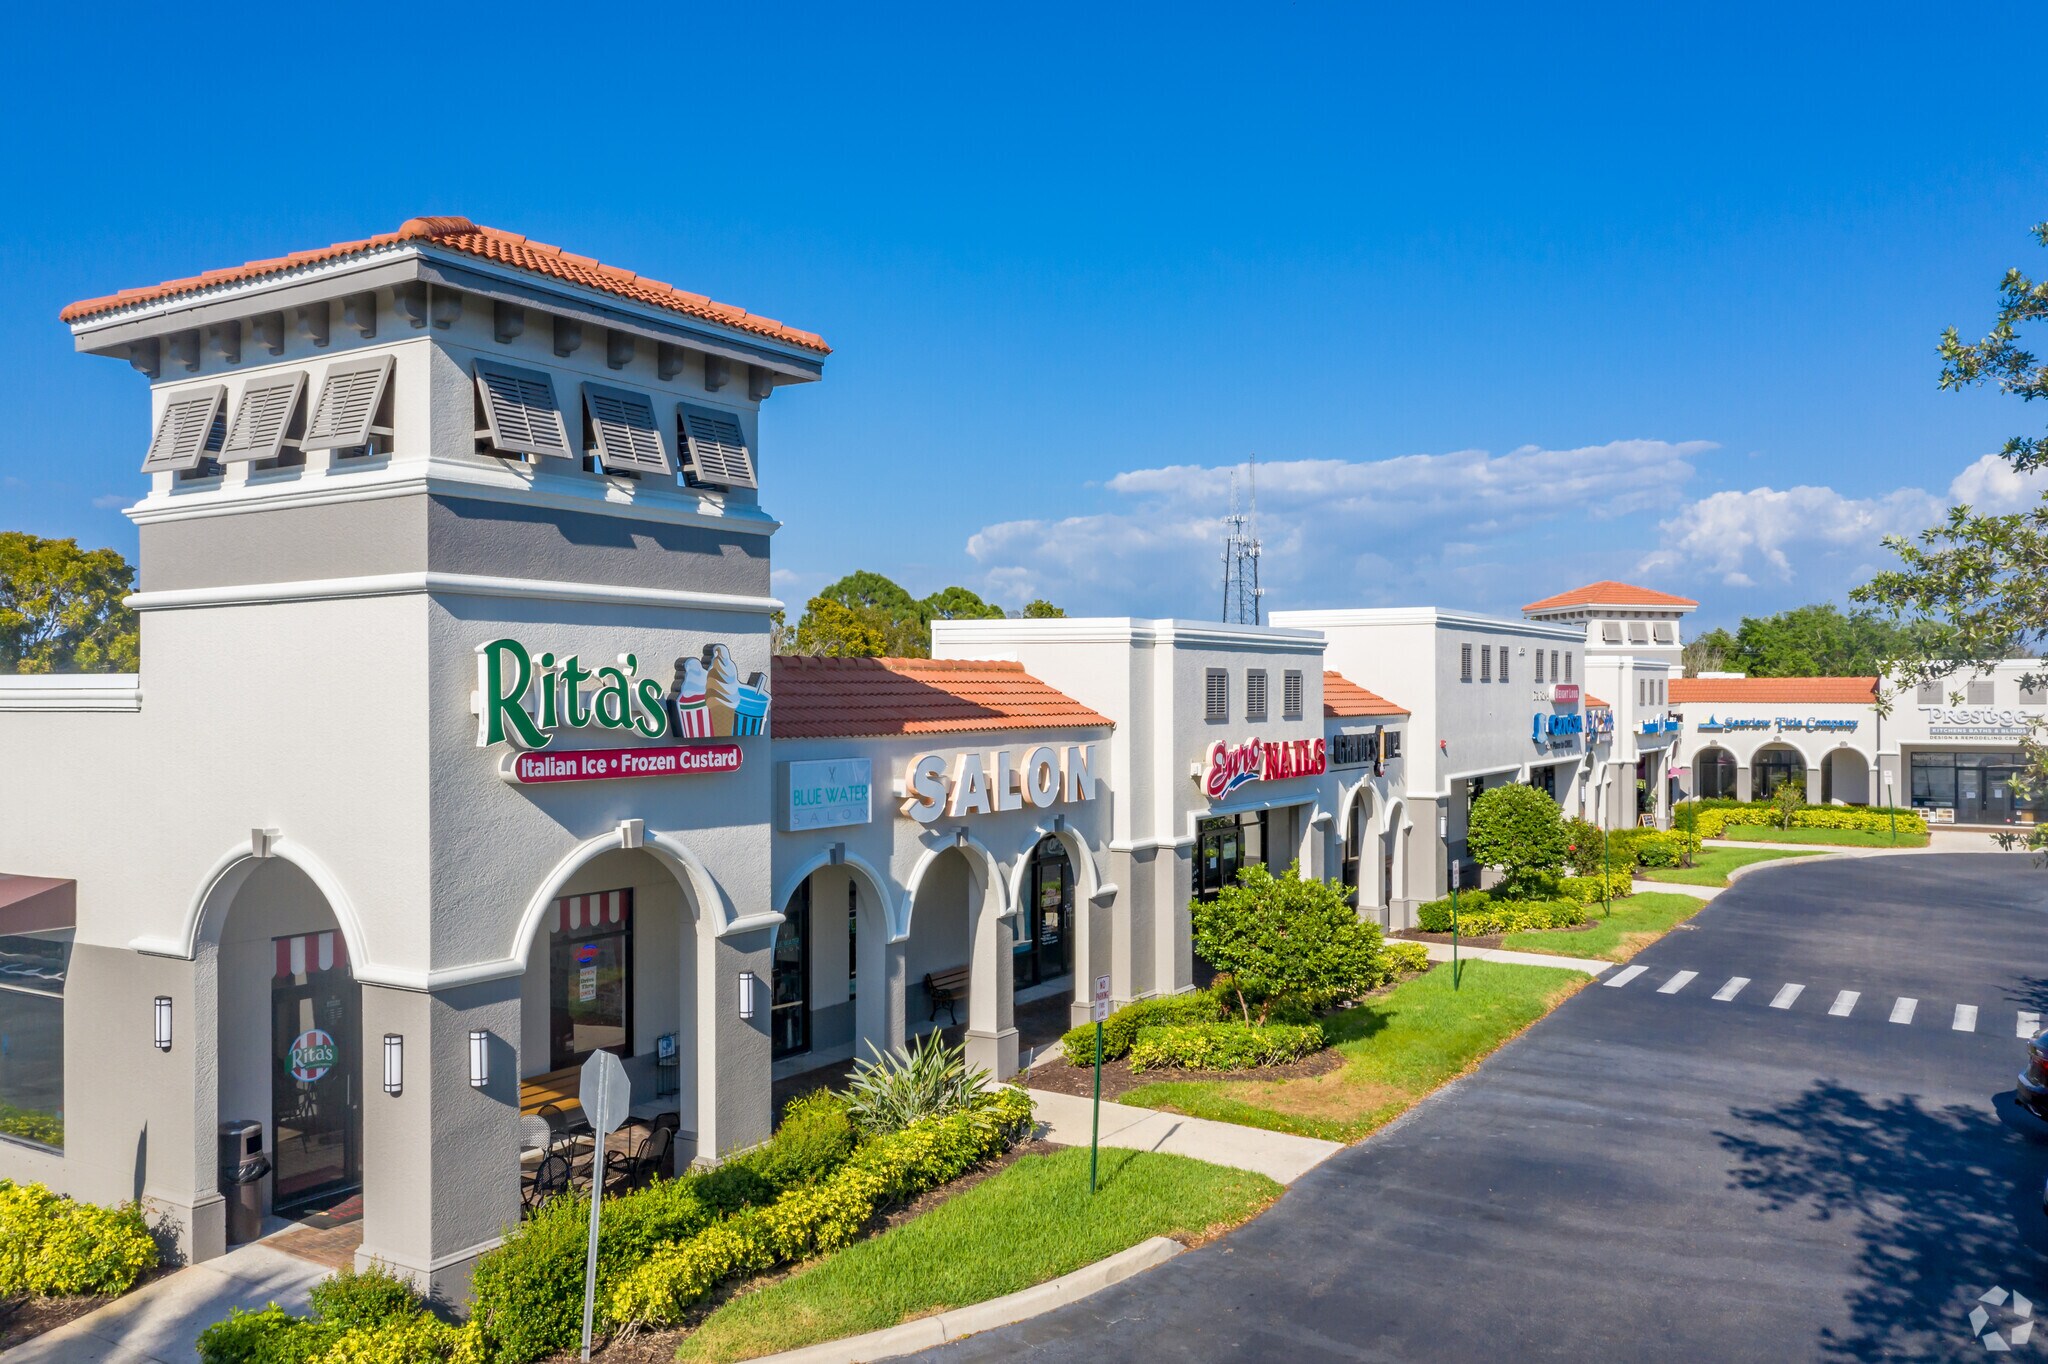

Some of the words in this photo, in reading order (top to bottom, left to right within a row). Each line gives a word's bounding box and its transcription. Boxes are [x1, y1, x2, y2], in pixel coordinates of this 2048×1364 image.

[479, 638, 668, 749] Rita's
[1724, 716, 1771, 730] Seaview
[1774, 716, 1802, 730] Title
[1806, 716, 1859, 732] Company
[1918, 706, 2044, 728] Prestige
[521, 756, 577, 779] Italian
[582, 756, 607, 775] Ice
[621, 752, 676, 773] Frozen
[680, 748, 738, 769] Custard
[1261, 737, 1327, 781] NAILS
[793, 787, 822, 807] BLUE
[825, 784, 869, 803] WATER
[901, 745, 1096, 823] SALON
[793, 808, 869, 825] SALON
[293, 1045, 333, 1068] Rita's
